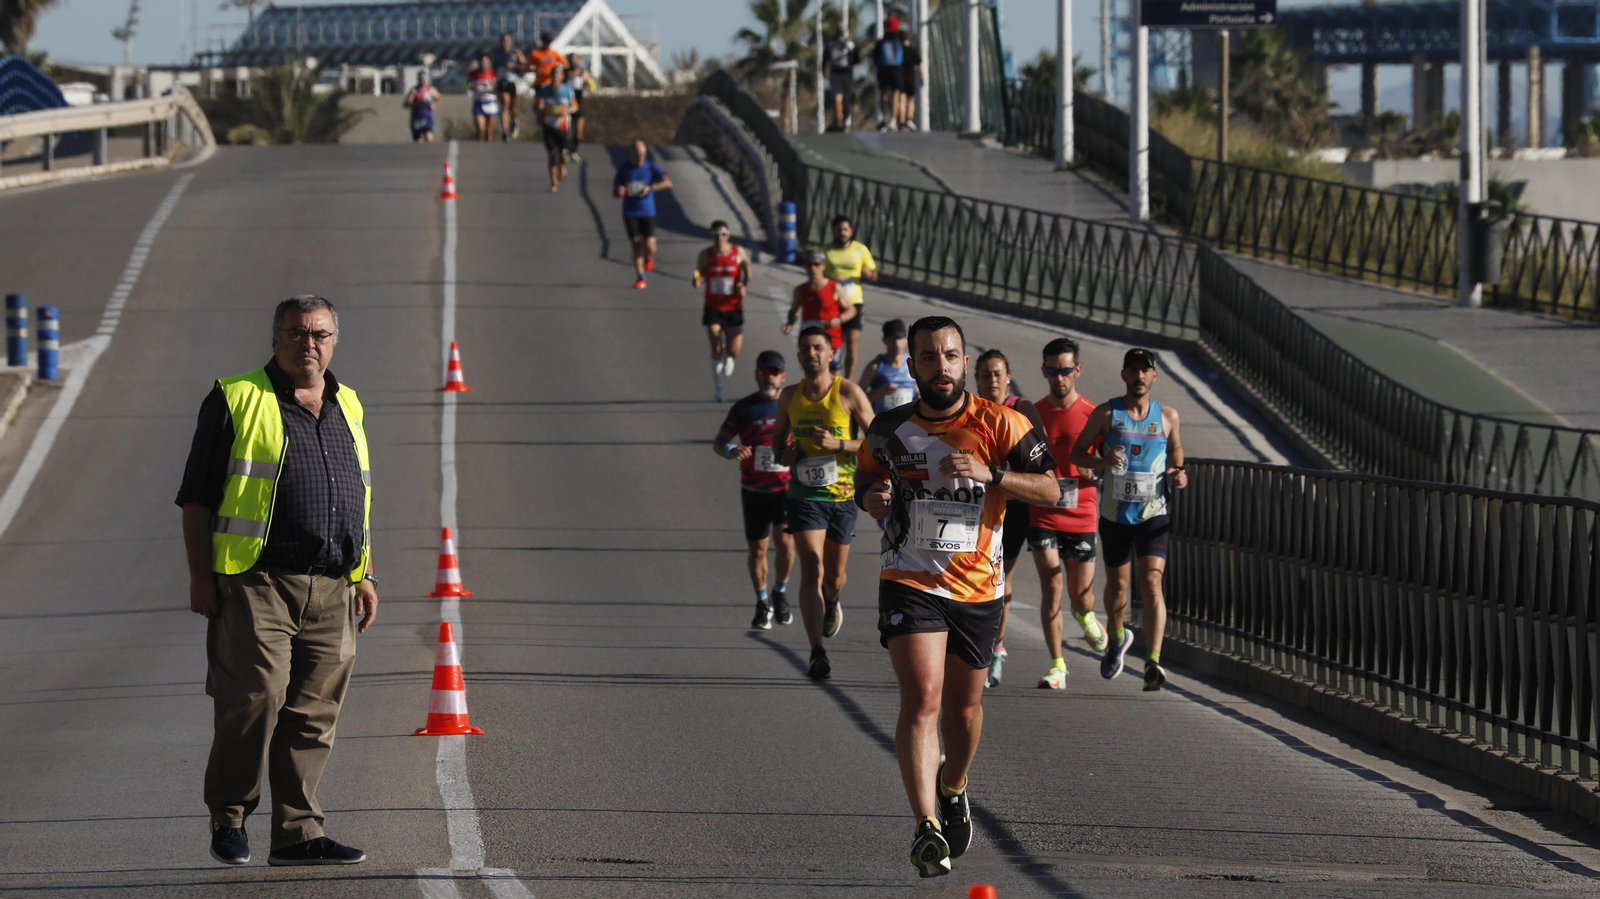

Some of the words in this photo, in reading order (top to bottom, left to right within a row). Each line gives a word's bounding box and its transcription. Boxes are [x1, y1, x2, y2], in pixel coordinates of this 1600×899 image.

[1181, 1, 1255, 12] Administración
[1209, 13, 1255, 24] Portuaria
[900, 453, 925, 463] MILAR
[805, 467, 825, 481] 130
[1124, 482, 1138, 495] 81
[937, 518, 949, 538] 7
[929, 541, 961, 550] EVOS
